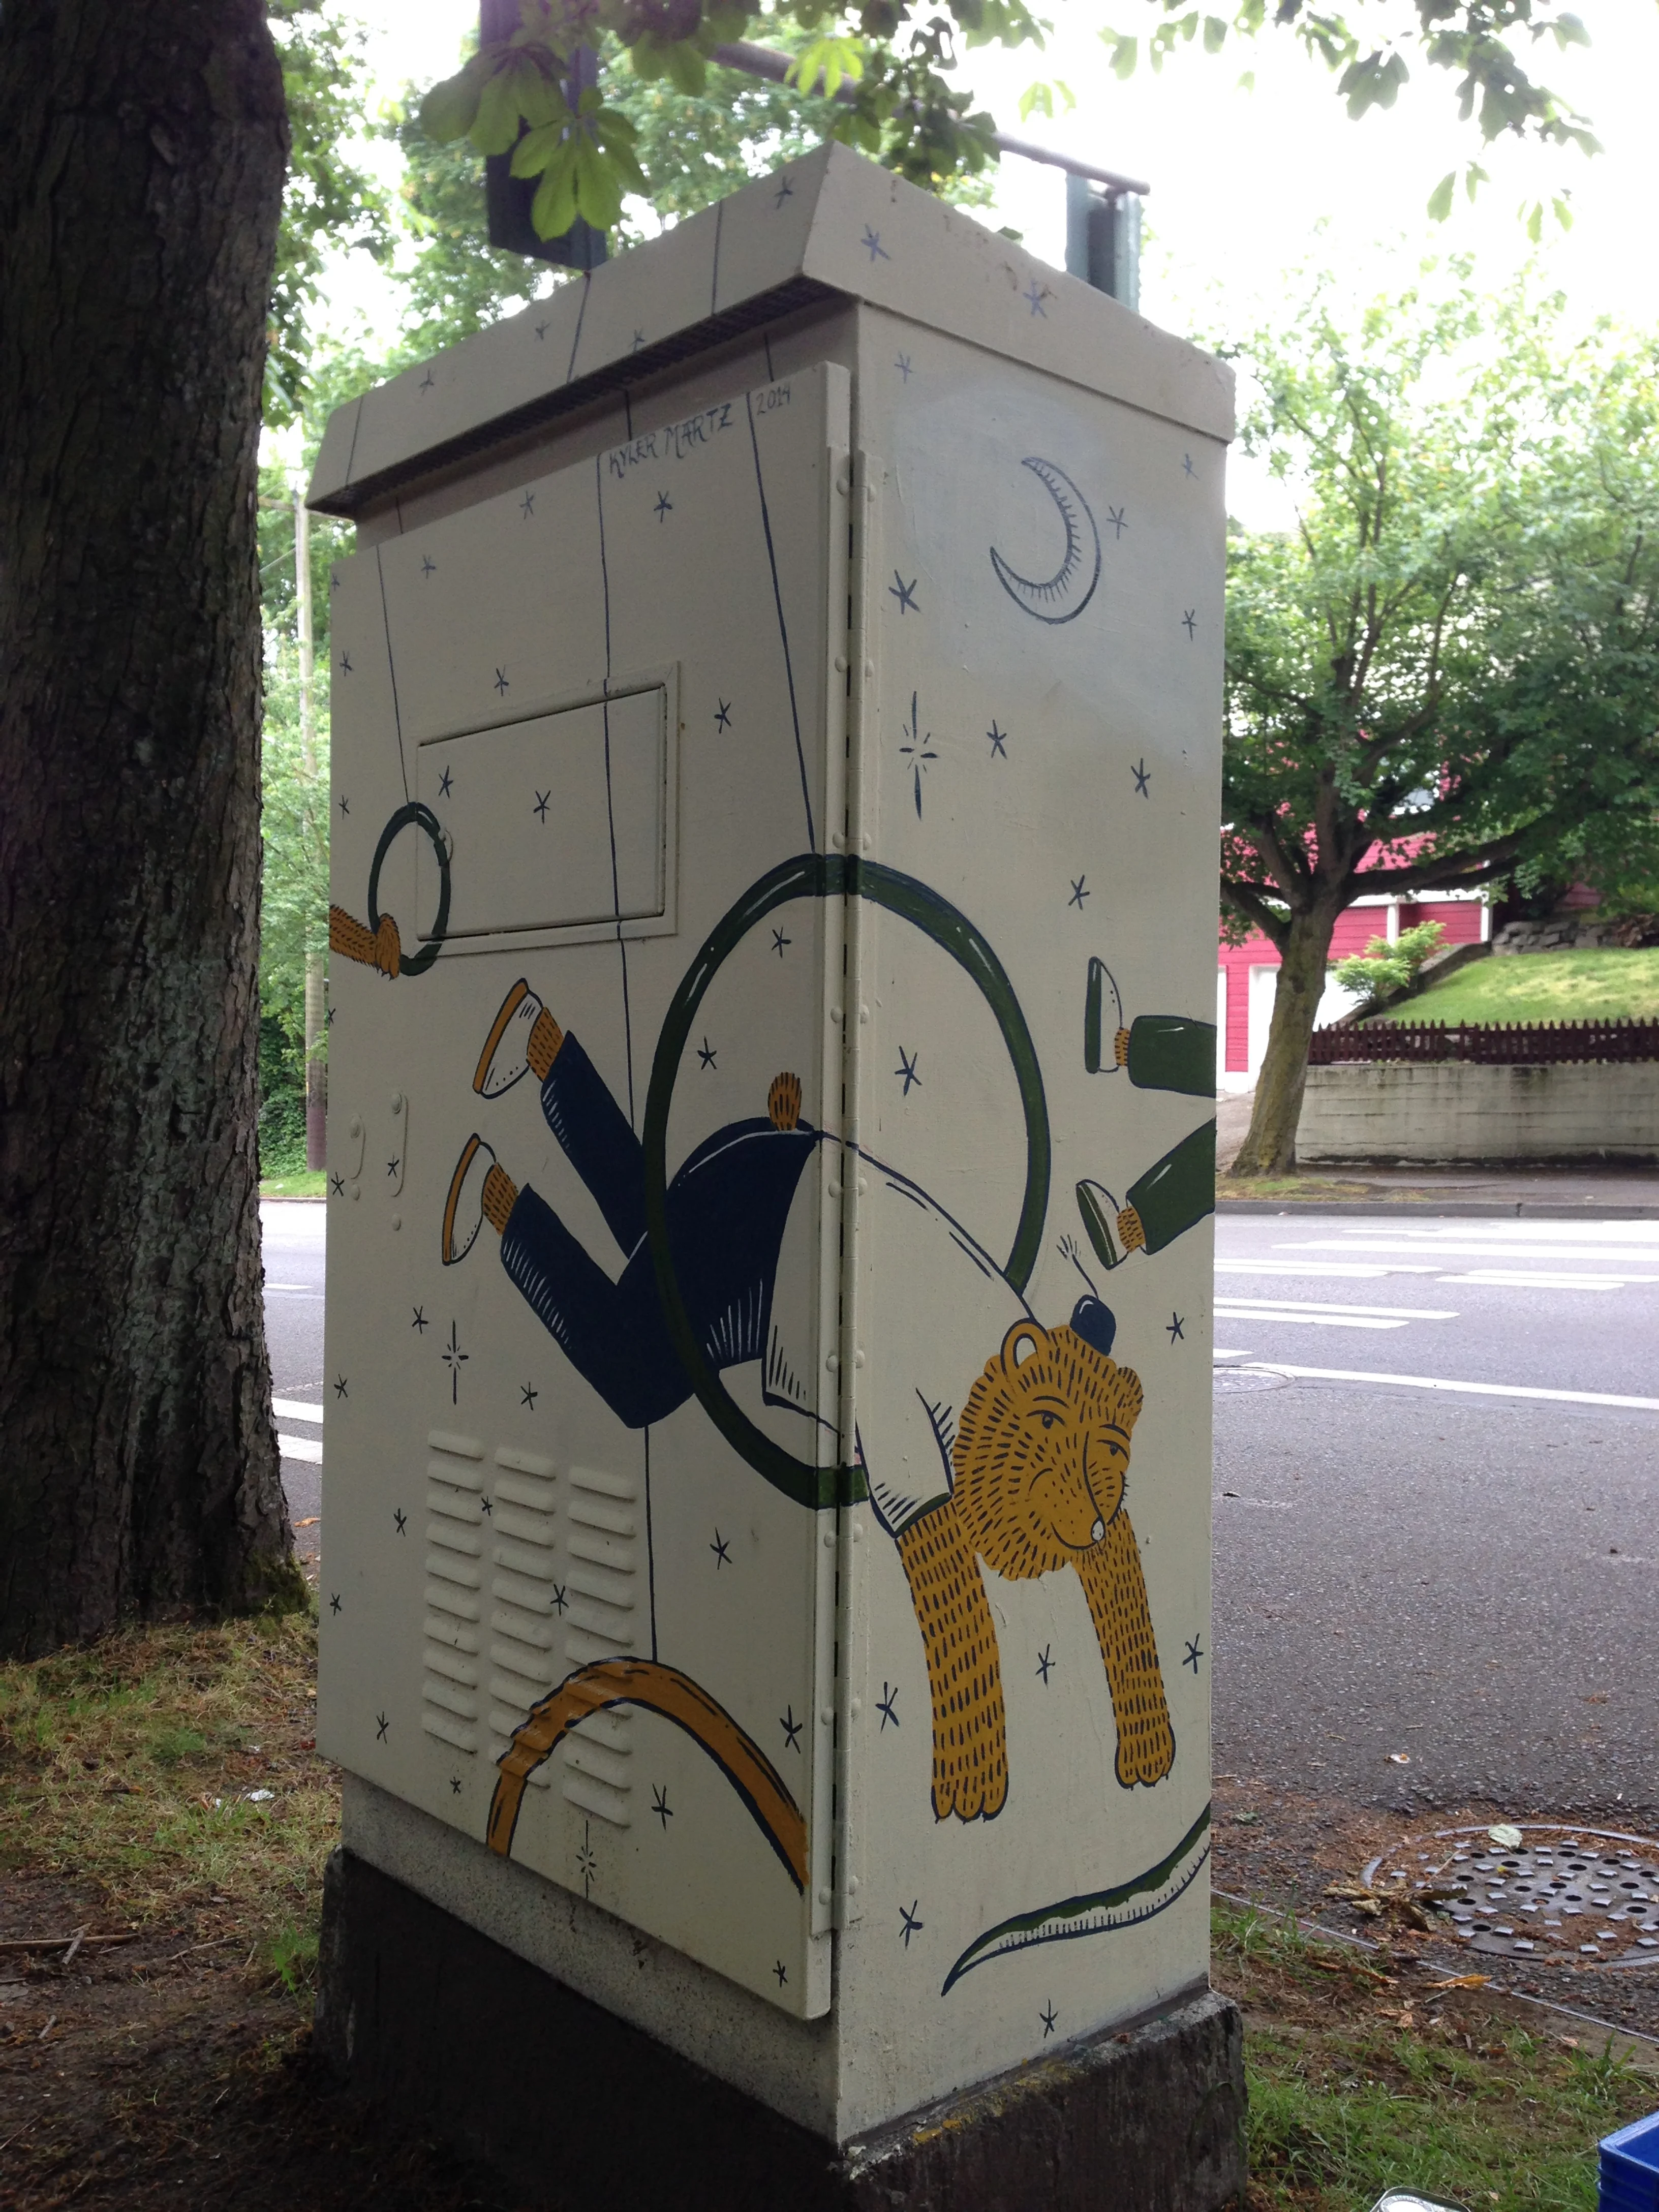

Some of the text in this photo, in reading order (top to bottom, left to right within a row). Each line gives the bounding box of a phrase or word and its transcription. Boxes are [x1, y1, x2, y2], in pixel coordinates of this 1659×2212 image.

[609, 383, 791, 478] KYLER MARTZ 2014
